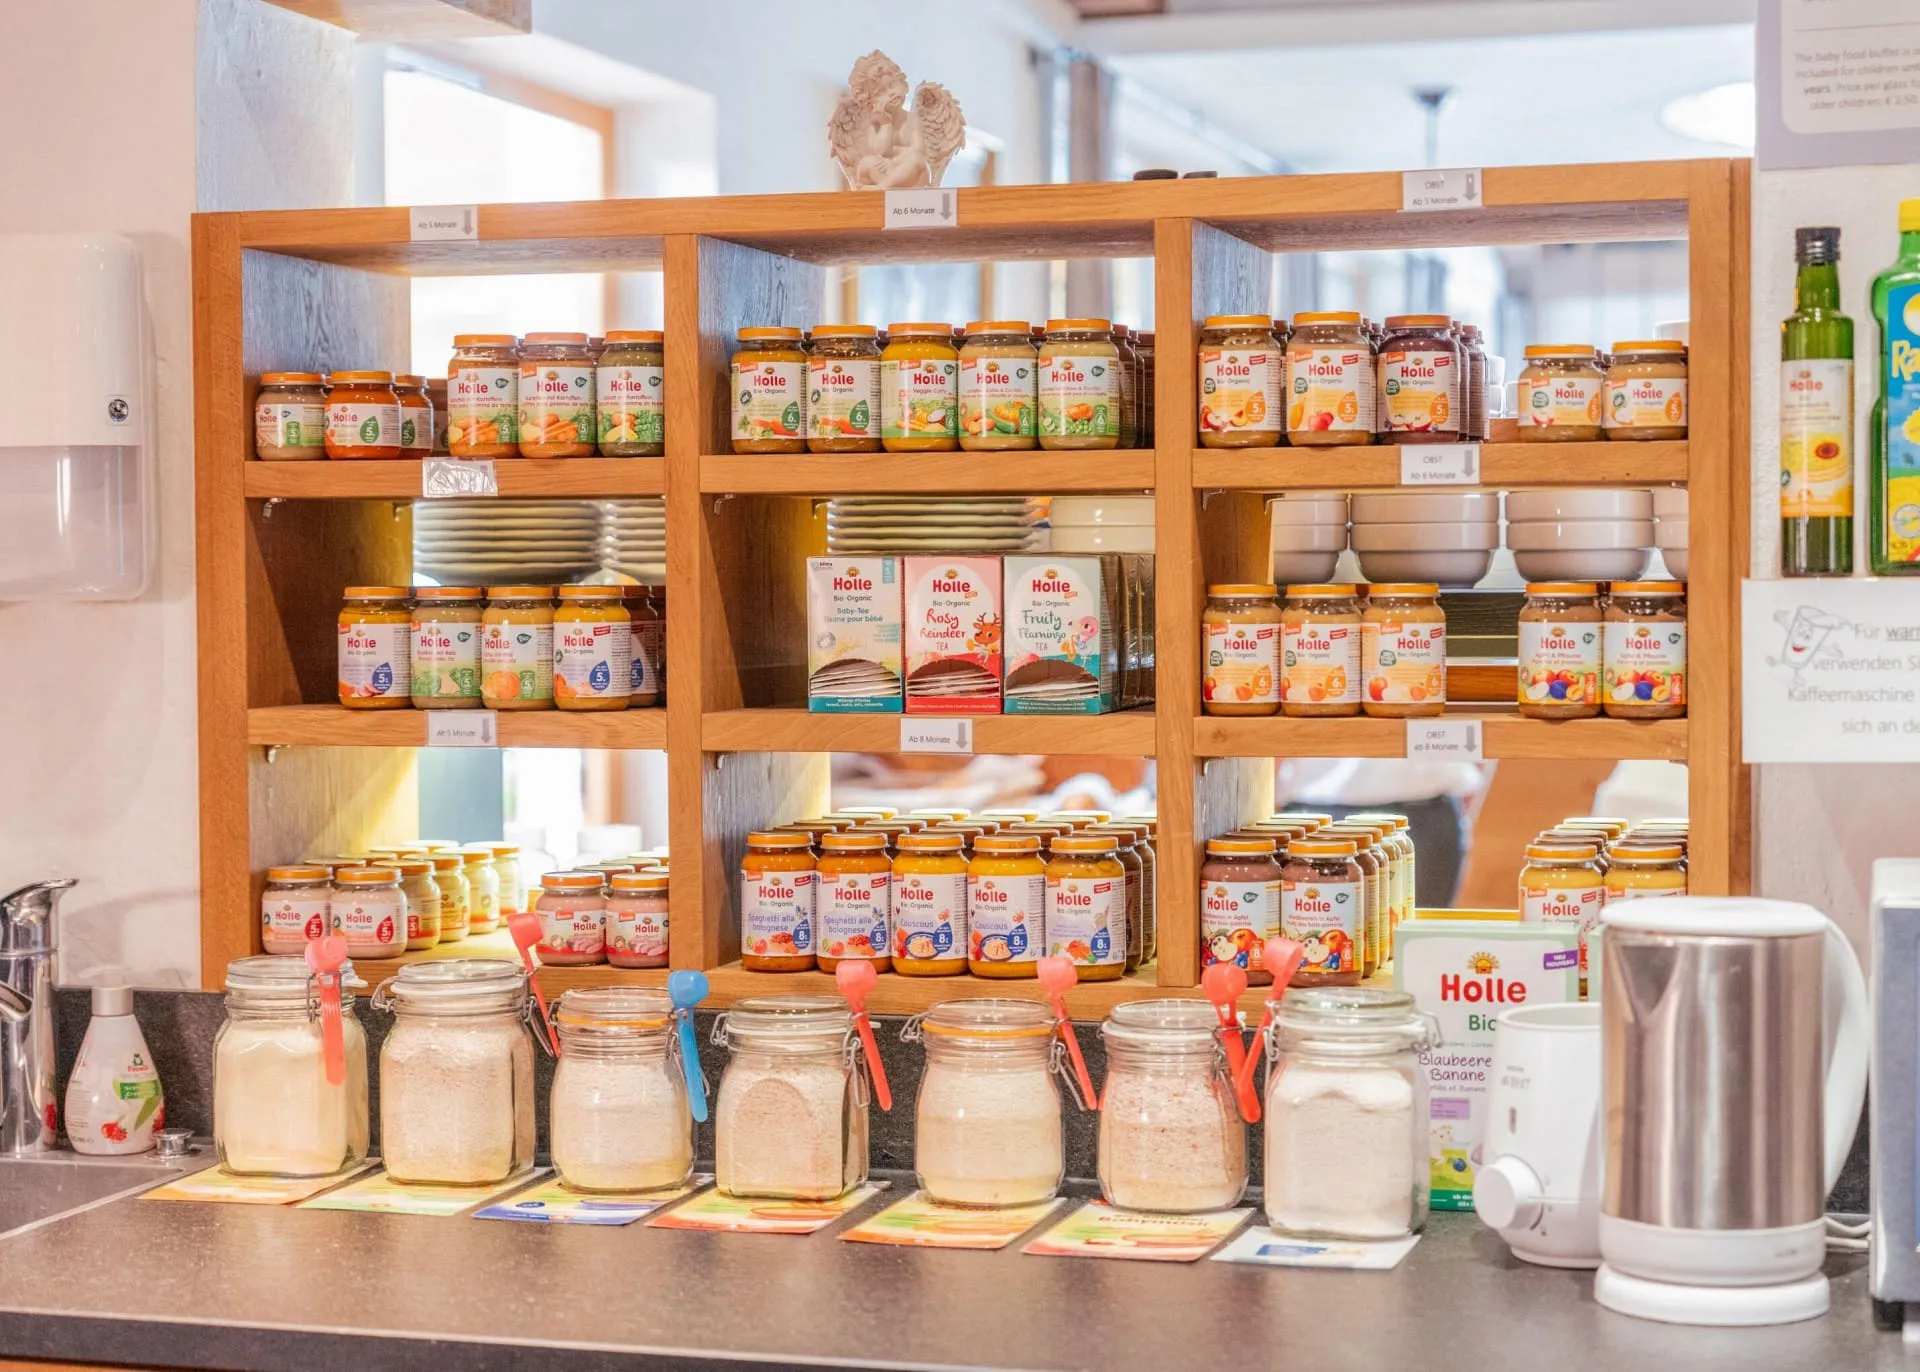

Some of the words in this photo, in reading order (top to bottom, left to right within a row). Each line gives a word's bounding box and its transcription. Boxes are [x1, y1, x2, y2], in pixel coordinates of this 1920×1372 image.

[1815, 52, 1840, 63] baby
[1216, 365, 1250, 376] Holle
[1308, 364, 1343, 376] Holle
[1401, 366, 1435, 377] Holle
[753, 374, 786, 386] Holle
[822, 373, 854, 385] Holle
[914, 373, 946, 385] Holle
[976, 373, 1009, 384] Holle
[1051, 371, 1084, 383] Holle
[458, 383, 488, 394] Holle
[536, 381, 568, 392] Holle
[610, 380, 641, 391] Holle
[1555, 388, 1585, 399] Holle
[1633, 389, 1663, 399] Holle
[259, 414, 278, 423] Holle
[333, 412, 358, 422] Holle
[833, 577, 872, 591] Holle
[933, 579, 970, 592] Holle
[1032, 579, 1070, 593] Holle
[847, 595, 873, 603] Organic
[946, 600, 971, 608] Organic
[1045, 600, 1070, 608] Organic
[926, 608, 959, 629] Rosy
[1022, 609, 1062, 631] Fruity
[920, 626, 967, 639] Reindeer
[1018, 628, 1067, 643] Flamingo
[347, 638, 377, 649] Holle
[420, 636, 451, 648] Holle
[485, 638, 510, 649] Holle
[564, 635, 594, 646] Holle
[936, 641, 949, 651] TEA
[1224, 639, 1257, 650] Holle
[1297, 638, 1330, 650] Holle
[1397, 637, 1431, 649] Holle
[1540, 638, 1576, 649] Holle
[1626, 638, 1661, 649] Holle
[1036, 642, 1048, 651] TEA
[1812, 656, 1902, 671] verwenden
[1788, 686, 1915, 702] Kaffeemaschine
[1841, 718, 1873, 734] sich
[1878, 721, 1897, 734] an
[925, 736, 951, 744] Monate
[759, 886, 794, 899] Holle
[835, 887, 870, 900] Holle
[900, 887, 933, 900] Holle
[975, 889, 1008, 902] Holle
[1057, 893, 1092, 906] Holle
[1207, 897, 1238, 911] Holle
[1295, 898, 1331, 912] Holle
[1543, 903, 1580, 916] Holle
[275, 911, 301, 921] Holle
[346, 914, 372, 923] Holle
[573, 922, 597, 931] Holle
[634, 924, 660, 933] Holle
[900, 919, 934, 928] Couscous
[975, 921, 1008, 930] Couscous
[828, 927, 865, 936] bolognese
[1441, 973, 1527, 1003] Holle
[1418, 1052, 1493, 1067] Blaubeere
[1431, 1068, 1486, 1081] Banane
